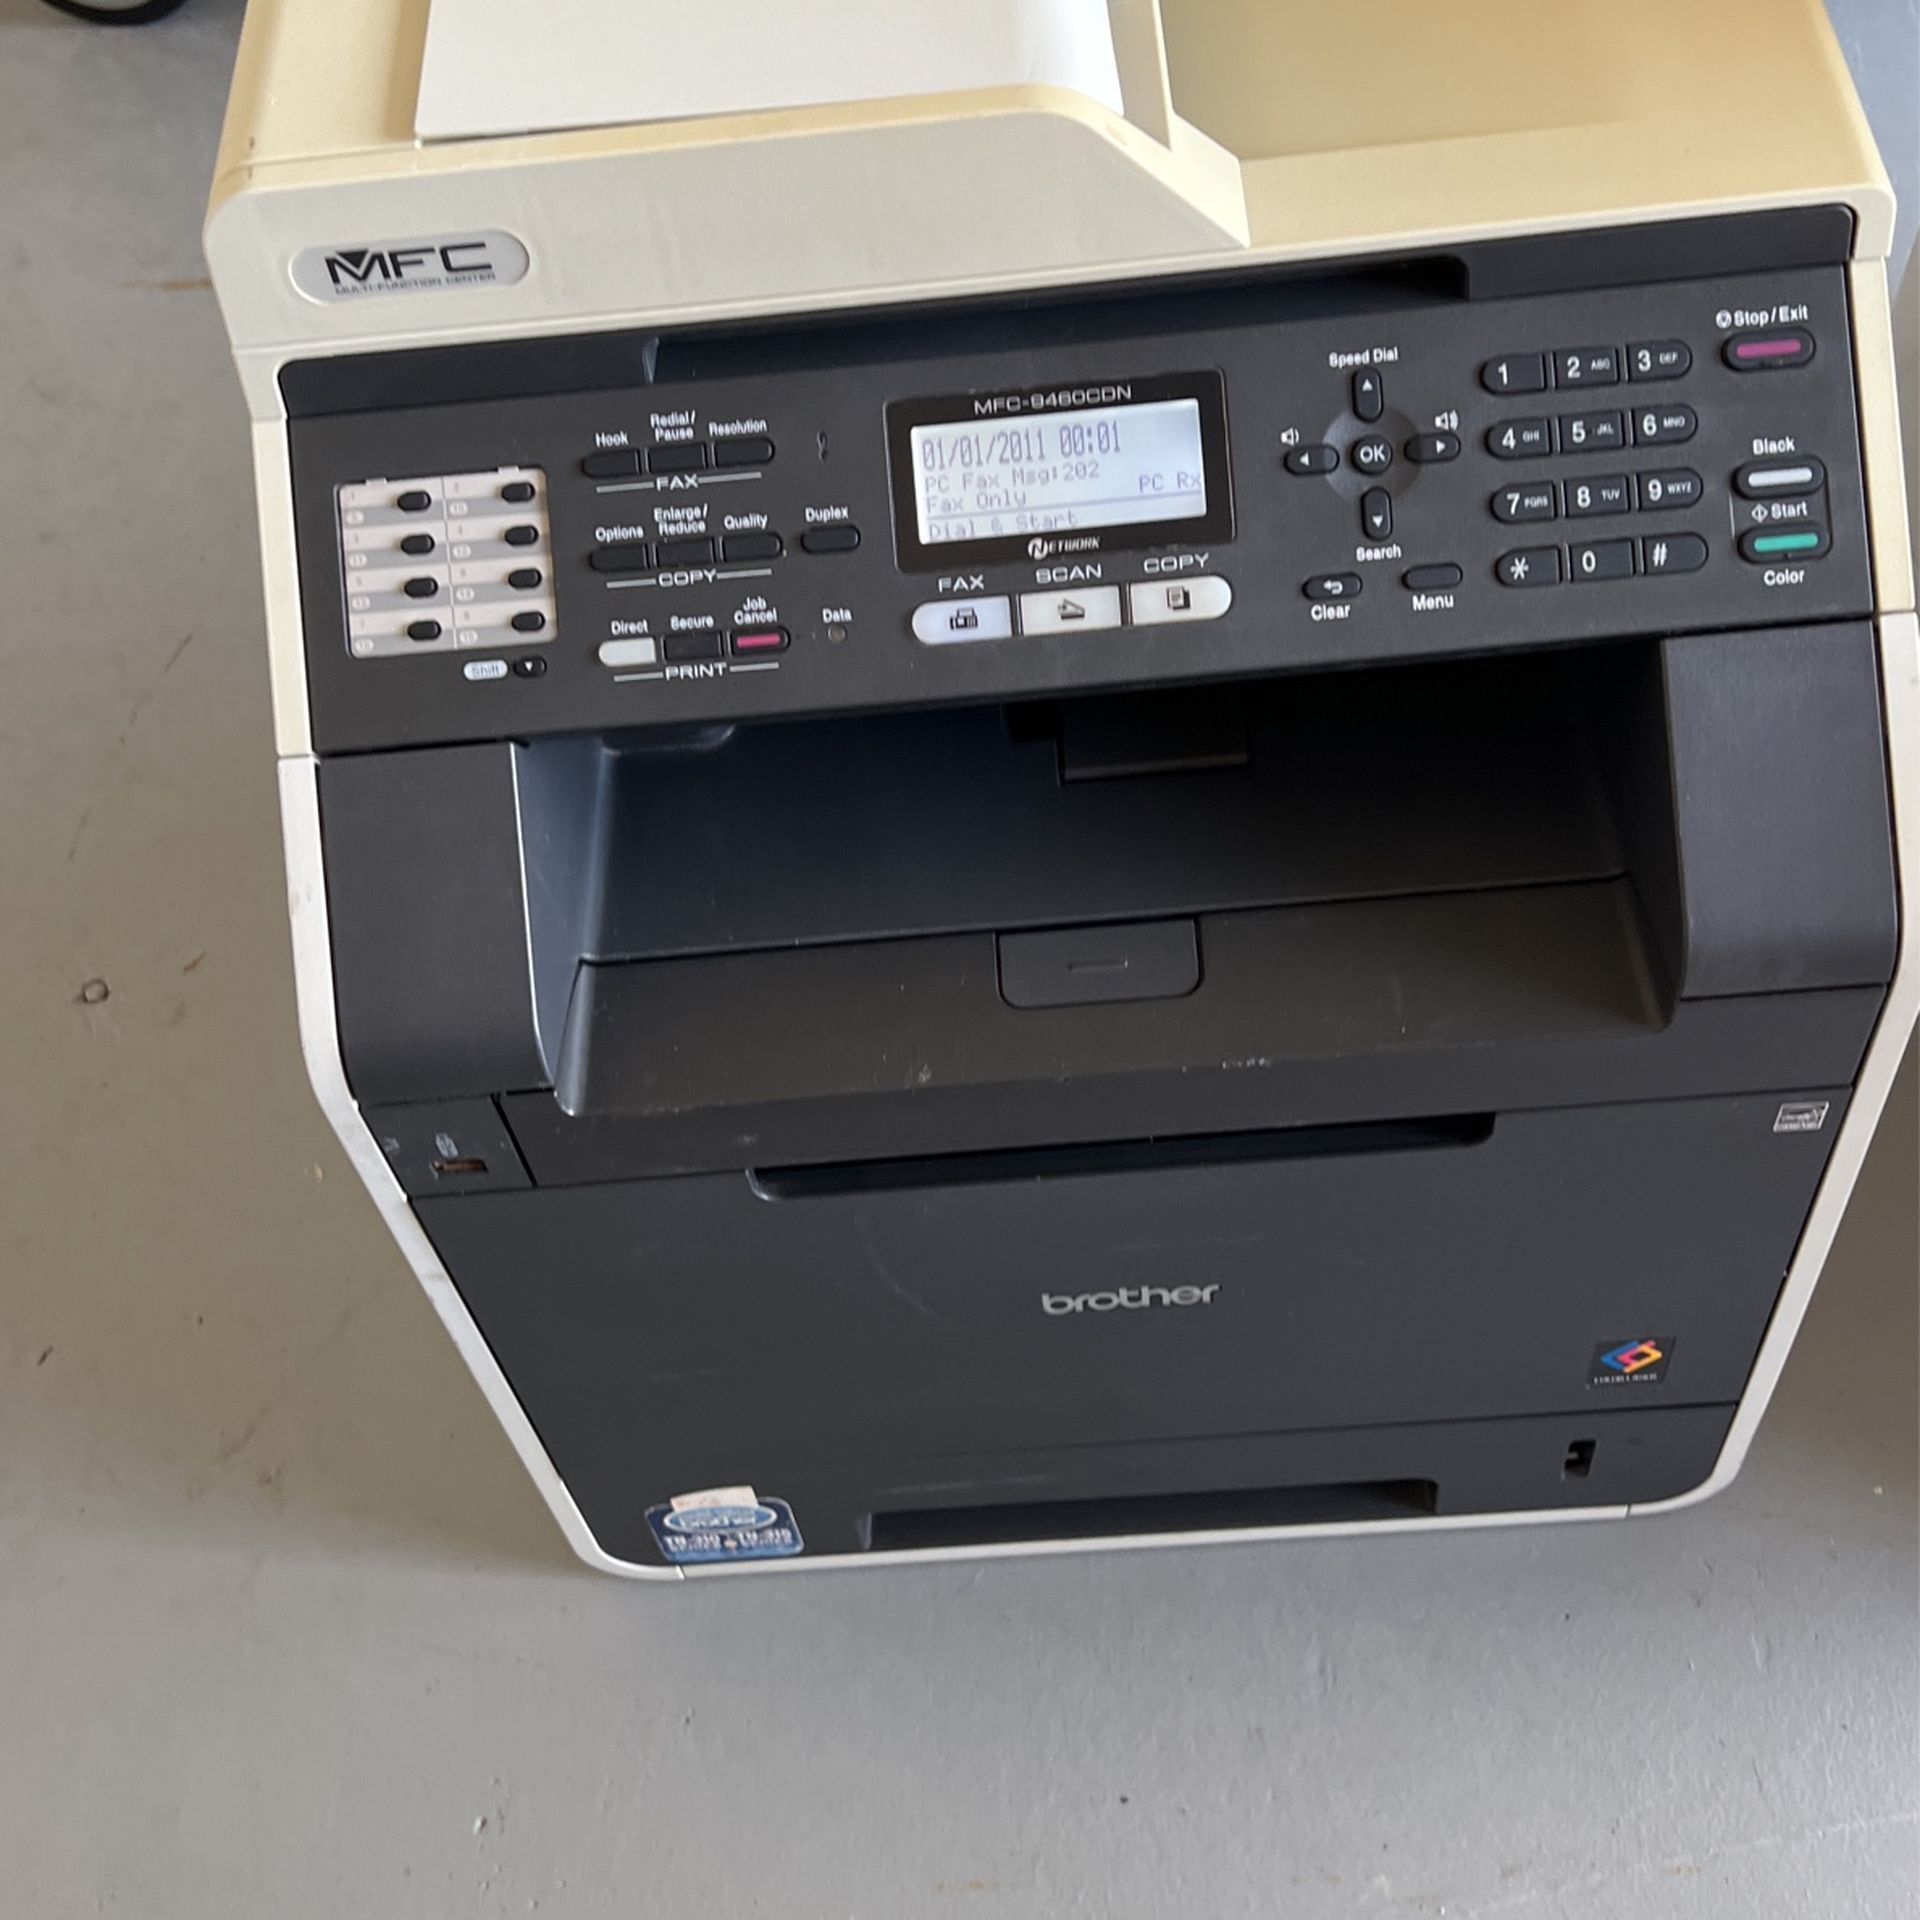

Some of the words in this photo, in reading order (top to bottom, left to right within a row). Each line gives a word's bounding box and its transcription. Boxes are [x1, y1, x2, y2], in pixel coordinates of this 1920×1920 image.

[325, 241, 492, 284] MFC
[1329, 350, 1370, 369] Speed
[1374, 347, 1398, 363] Dial
[1567, 357, 1581, 378] 2
[1638, 349, 1651, 371] 3
[1498, 363, 1508, 385] 1
[655, 427, 694, 442] Pause
[709, 419, 767, 437] Resolution
[1572, 421, 1586, 443] 5
[1643, 414, 1657, 436] 6
[1663, 416, 1685, 428] MNO
[596, 431, 629, 447] Hook
[921, 429, 1047, 470] 01/01/2011
[1060, 420, 1121, 456] 00:01
[1501, 428, 1516, 450] 4
[1752, 436, 1795, 455] Black
[1359, 444, 1386, 464] OK
[656, 474, 699, 491] FAX
[925, 475, 950, 493] PC
[963, 472, 999, 491] Fax
[1139, 474, 1164, 492] PC
[1177, 471, 1201, 488] Rx
[1648, 479, 1662, 501] 9
[927, 496, 964, 514] Fax
[977, 489, 1026, 510] Only
[1507, 492, 1520, 514] 7
[1577, 486, 1591, 508] 8
[1602, 489, 1620, 501] TUV
[805, 506, 849, 524] Duplex
[1770, 502, 1808, 519] Start
[658, 520, 706, 536] Reduce
[724, 513, 768, 531] Quality
[929, 519, 975, 540] Dial
[1016, 509, 1077, 532] Start
[595, 525, 644, 542] Options
[1356, 544, 1402, 562] Search
[1582, 551, 1596, 573] 0
[1143, 553, 1209, 574] COPY
[658, 569, 717, 587] COPY
[1036, 563, 1102, 584] SCAN
[1763, 570, 1805, 586] Color
[938, 574, 984, 593] FAX
[743, 596, 767, 611] Job
[1412, 594, 1454, 611] Menu
[734, 608, 777, 625] Cancel
[822, 608, 852, 624] Data
[1310, 604, 1351, 621] Clear
[611, 620, 648, 635] Direct
[670, 615, 714, 630] Secure
[665, 662, 727, 681] PRINT
[1041, 1284, 1219, 1315] brother
